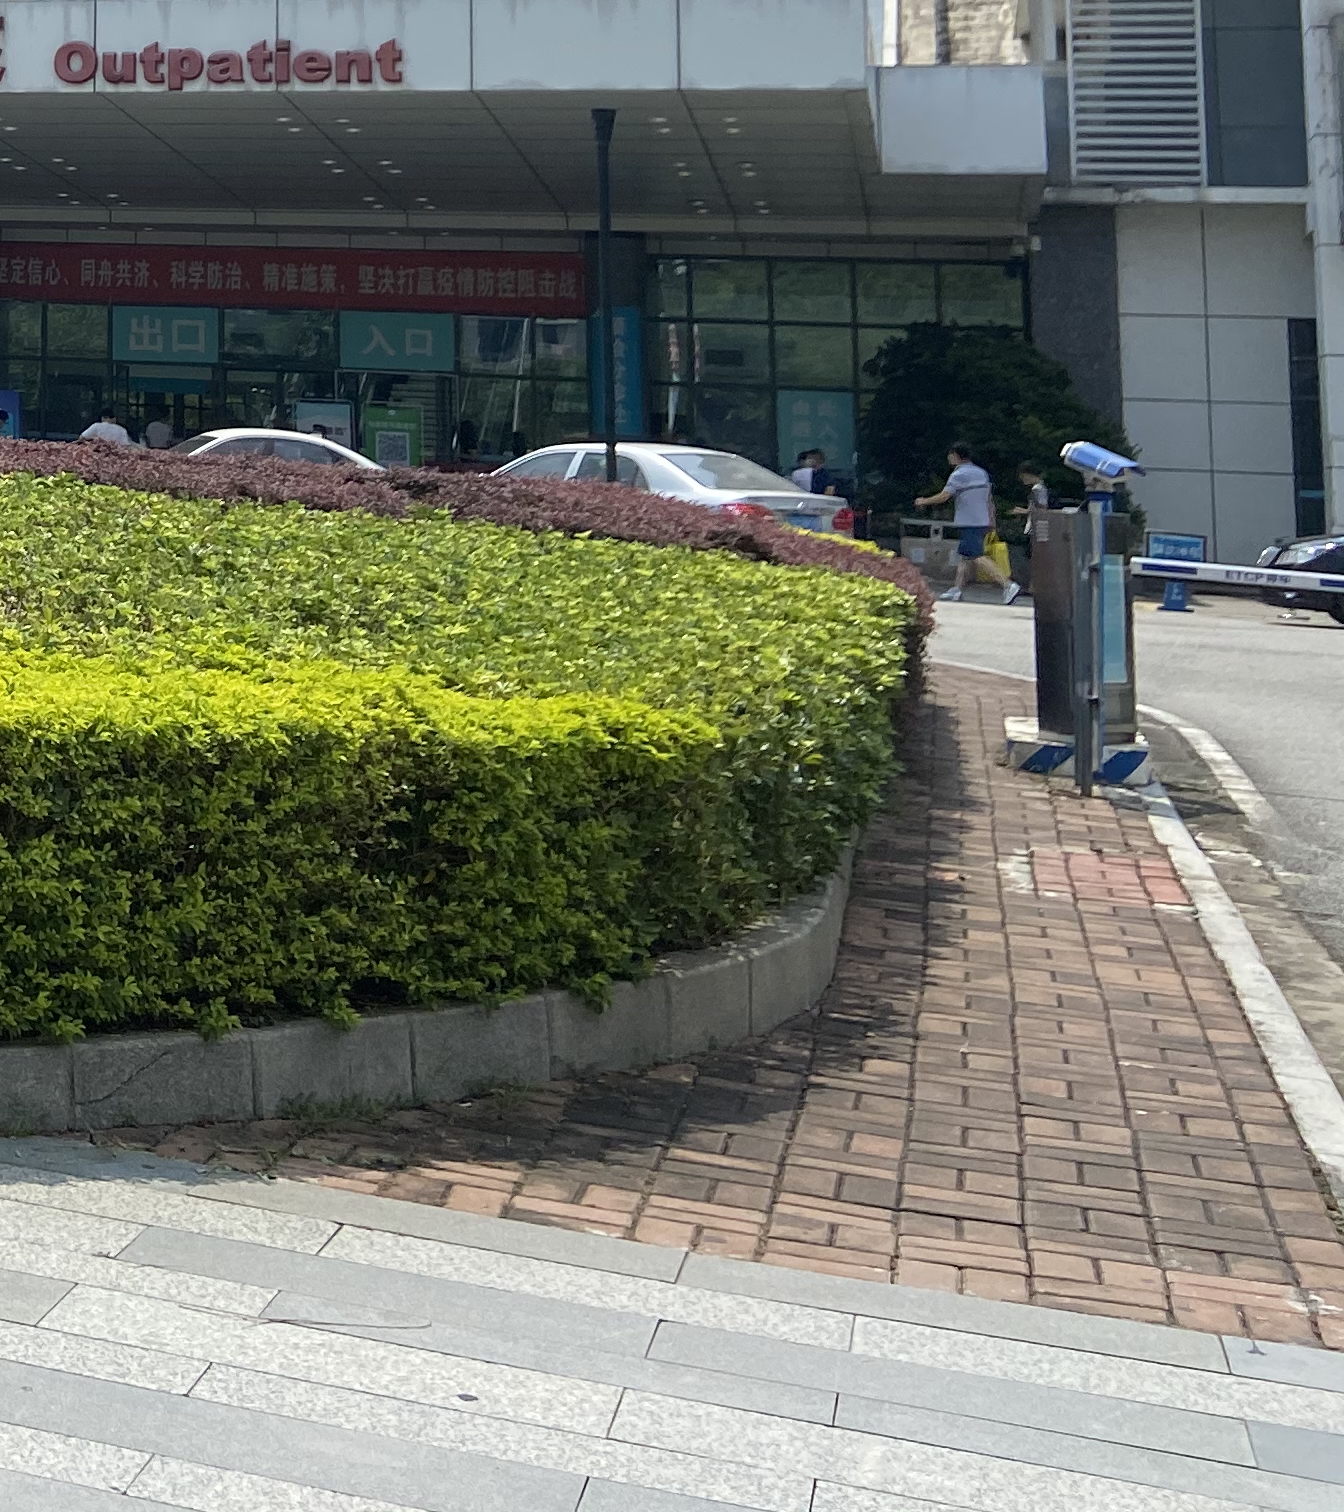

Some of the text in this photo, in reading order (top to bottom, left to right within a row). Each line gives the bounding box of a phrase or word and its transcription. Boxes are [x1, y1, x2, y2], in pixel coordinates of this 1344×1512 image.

[53, 38, 404, 90] Outpatient
[128, 314, 206, 353] 出口
[362, 324, 434, 357] 入口
